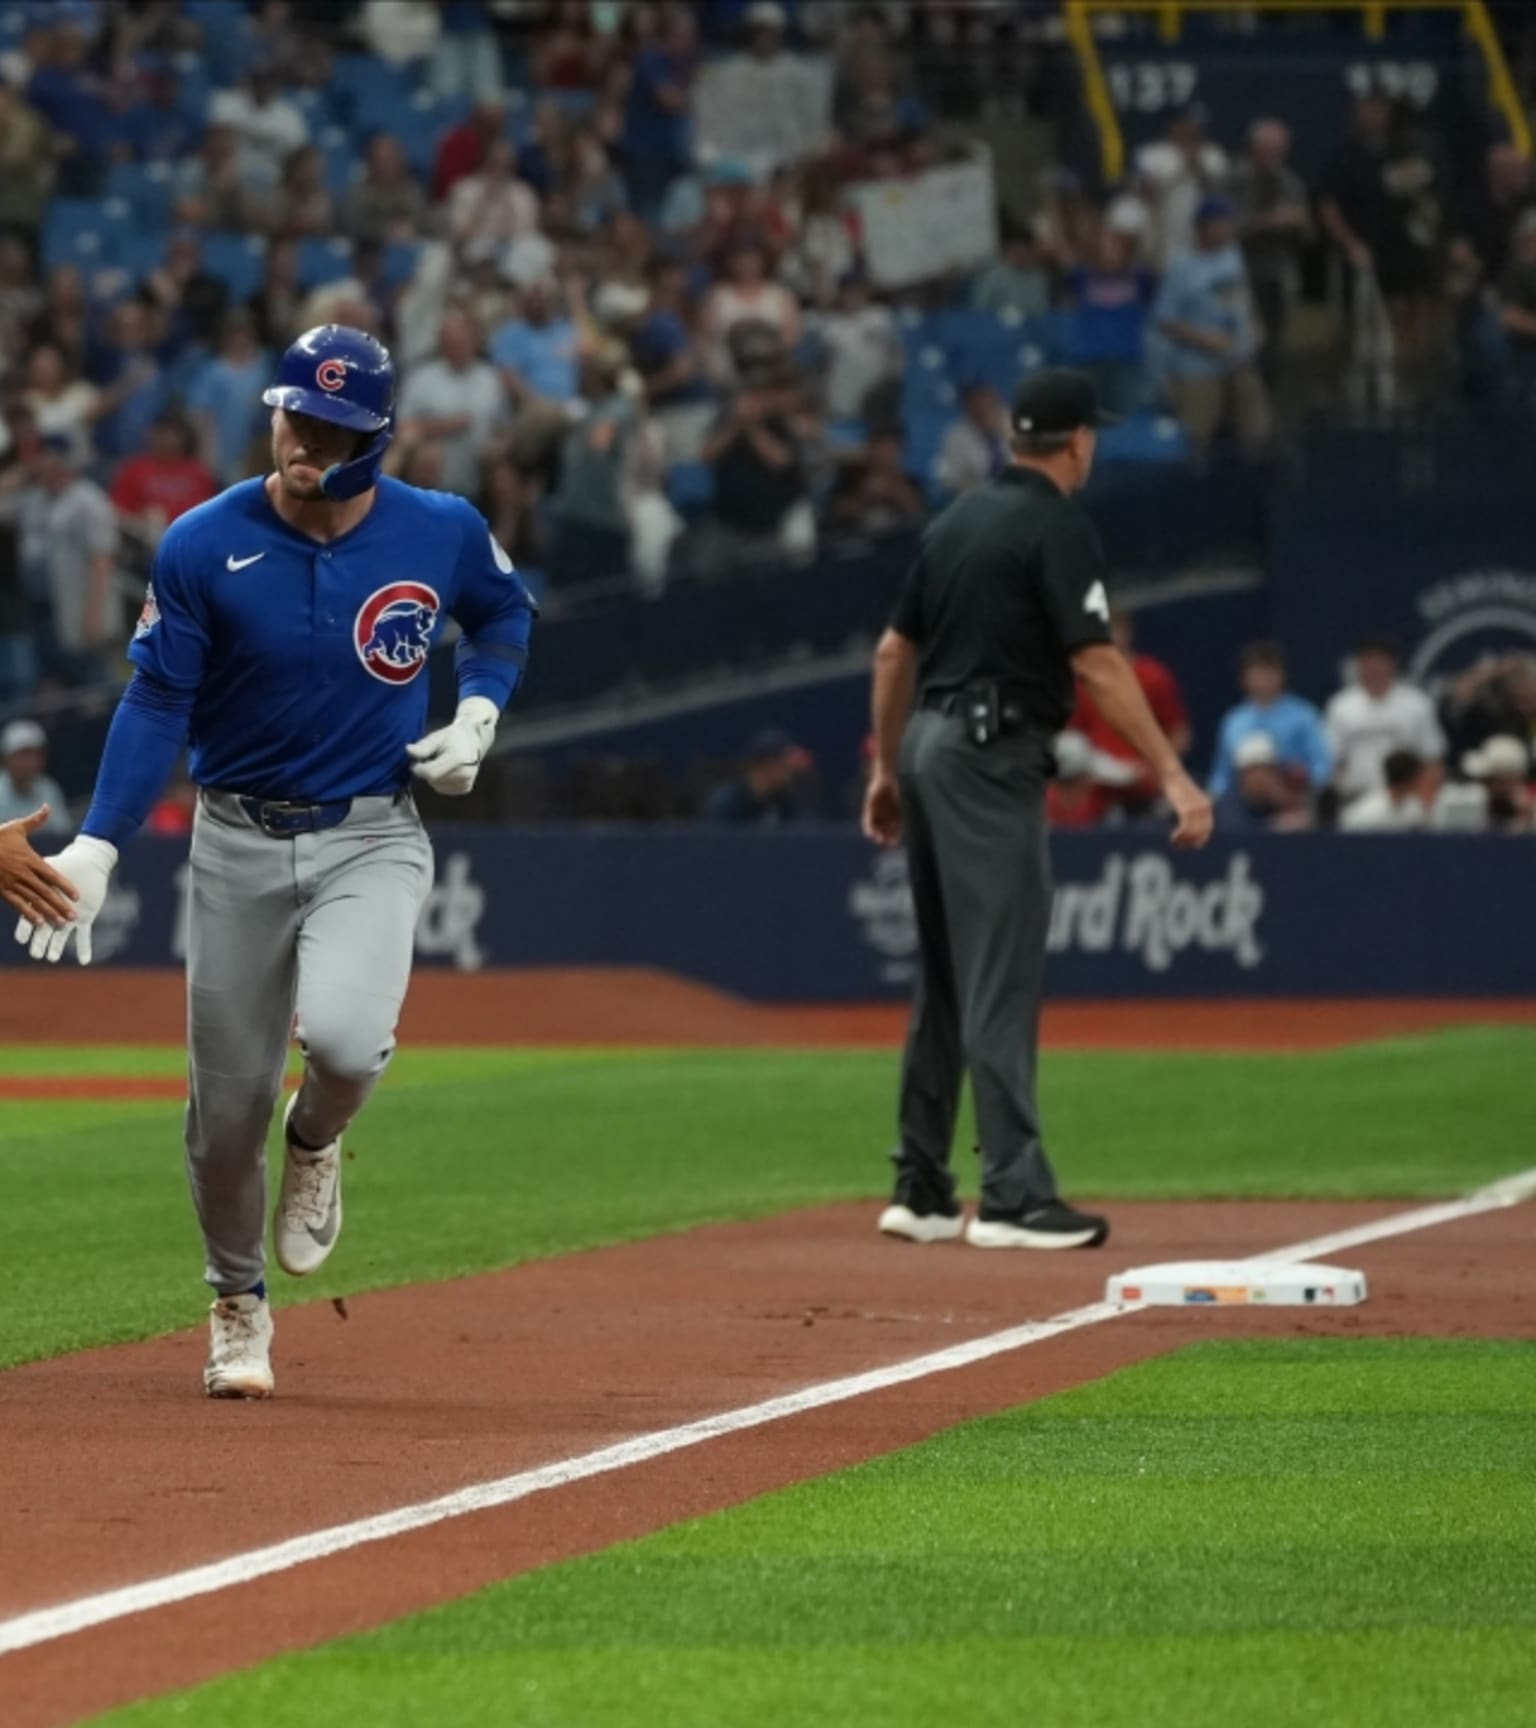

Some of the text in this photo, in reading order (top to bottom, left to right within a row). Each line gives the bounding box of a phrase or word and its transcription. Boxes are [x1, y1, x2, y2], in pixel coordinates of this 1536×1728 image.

[315, 358, 347, 392] C
[353, 579, 441, 685] C
[1083, 579, 1110, 622] 4
[1123, 850, 1267, 972] Rock
